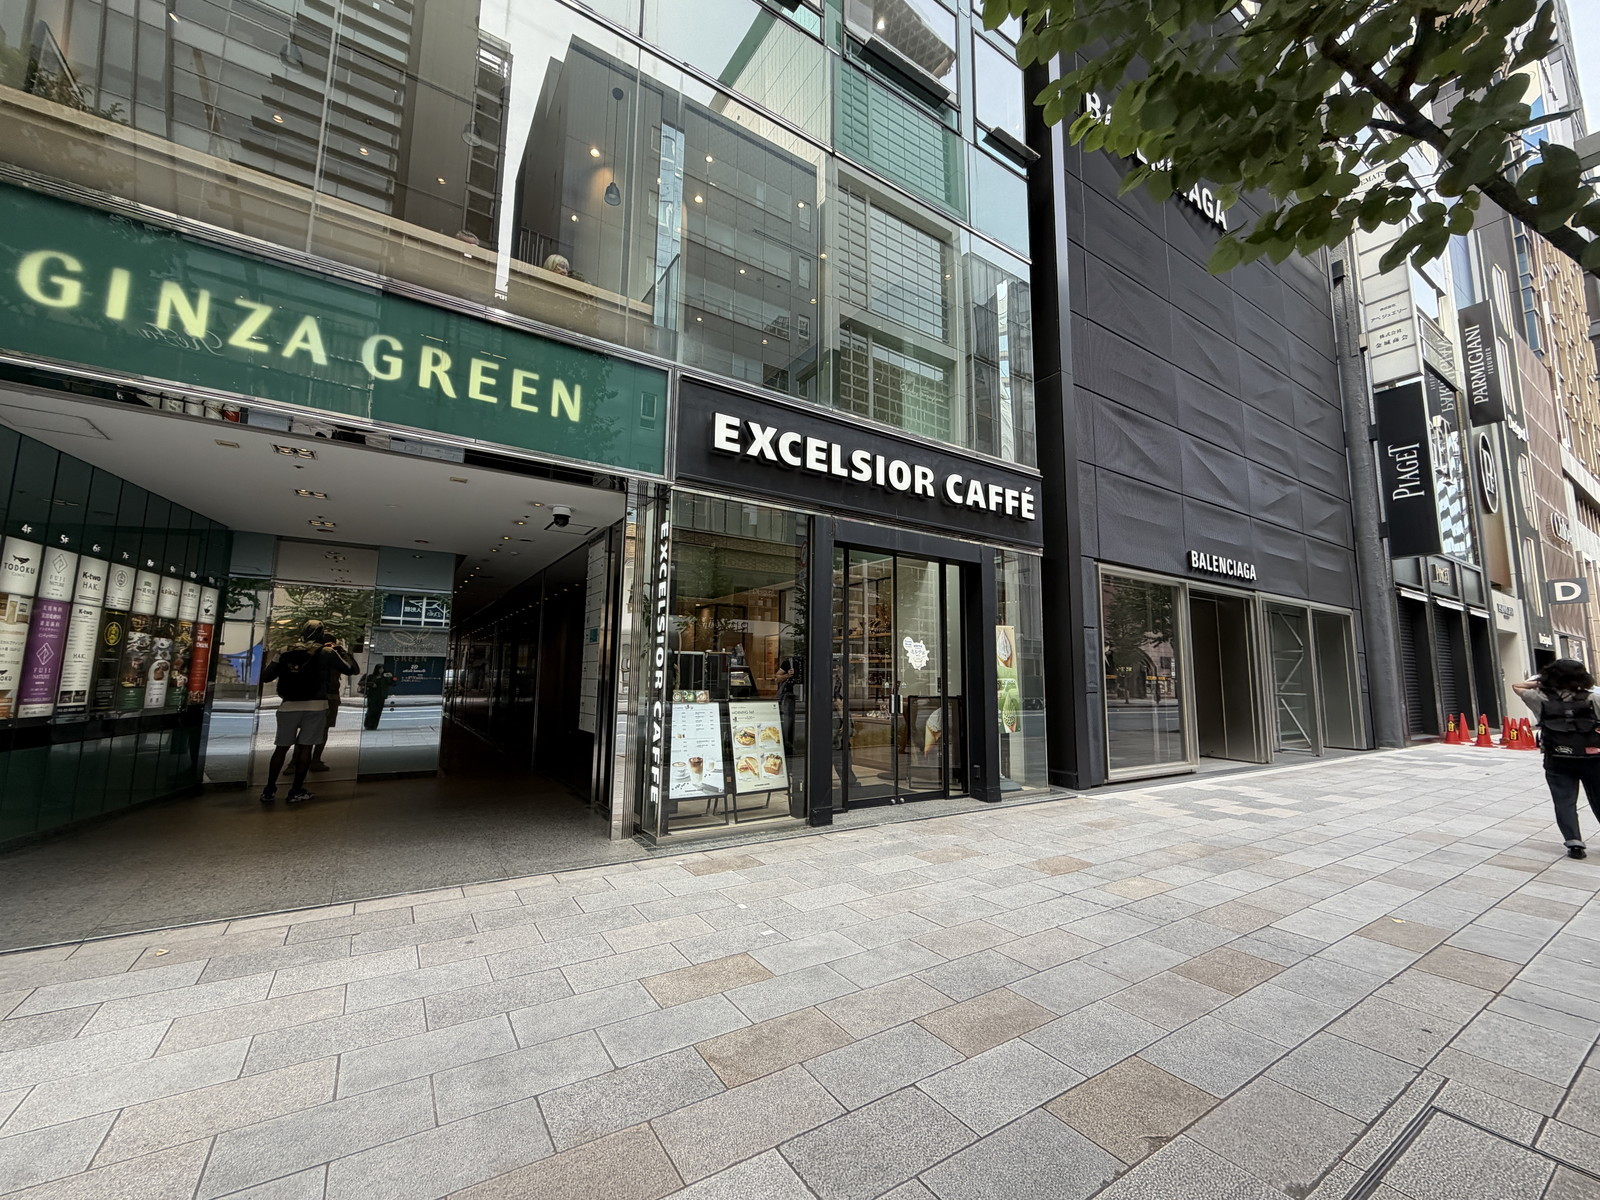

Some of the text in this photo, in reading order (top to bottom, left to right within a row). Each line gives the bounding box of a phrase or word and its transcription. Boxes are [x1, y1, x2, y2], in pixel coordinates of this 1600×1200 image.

[17, 249, 582, 422] GINZA GREEN
[1465, 324, 1489, 405] PARMIGIANI
[713, 411, 1036, 520] EXCELSIOR CAFFÉ
[1388, 442, 1425, 501] PIAGET
[21, 524, 32, 534] 4F
[60, 534, 70, 544] 5F
[92, 544, 101, 552] 6F
[4, 562, 36, 575] TODOKU
[82, 571, 101, 581] K-two
[1191, 550, 1257, 581] BALENCIAGA
[1554, 581, 1582, 602] D
[654, 521, 670, 690] EXCELSIOR
